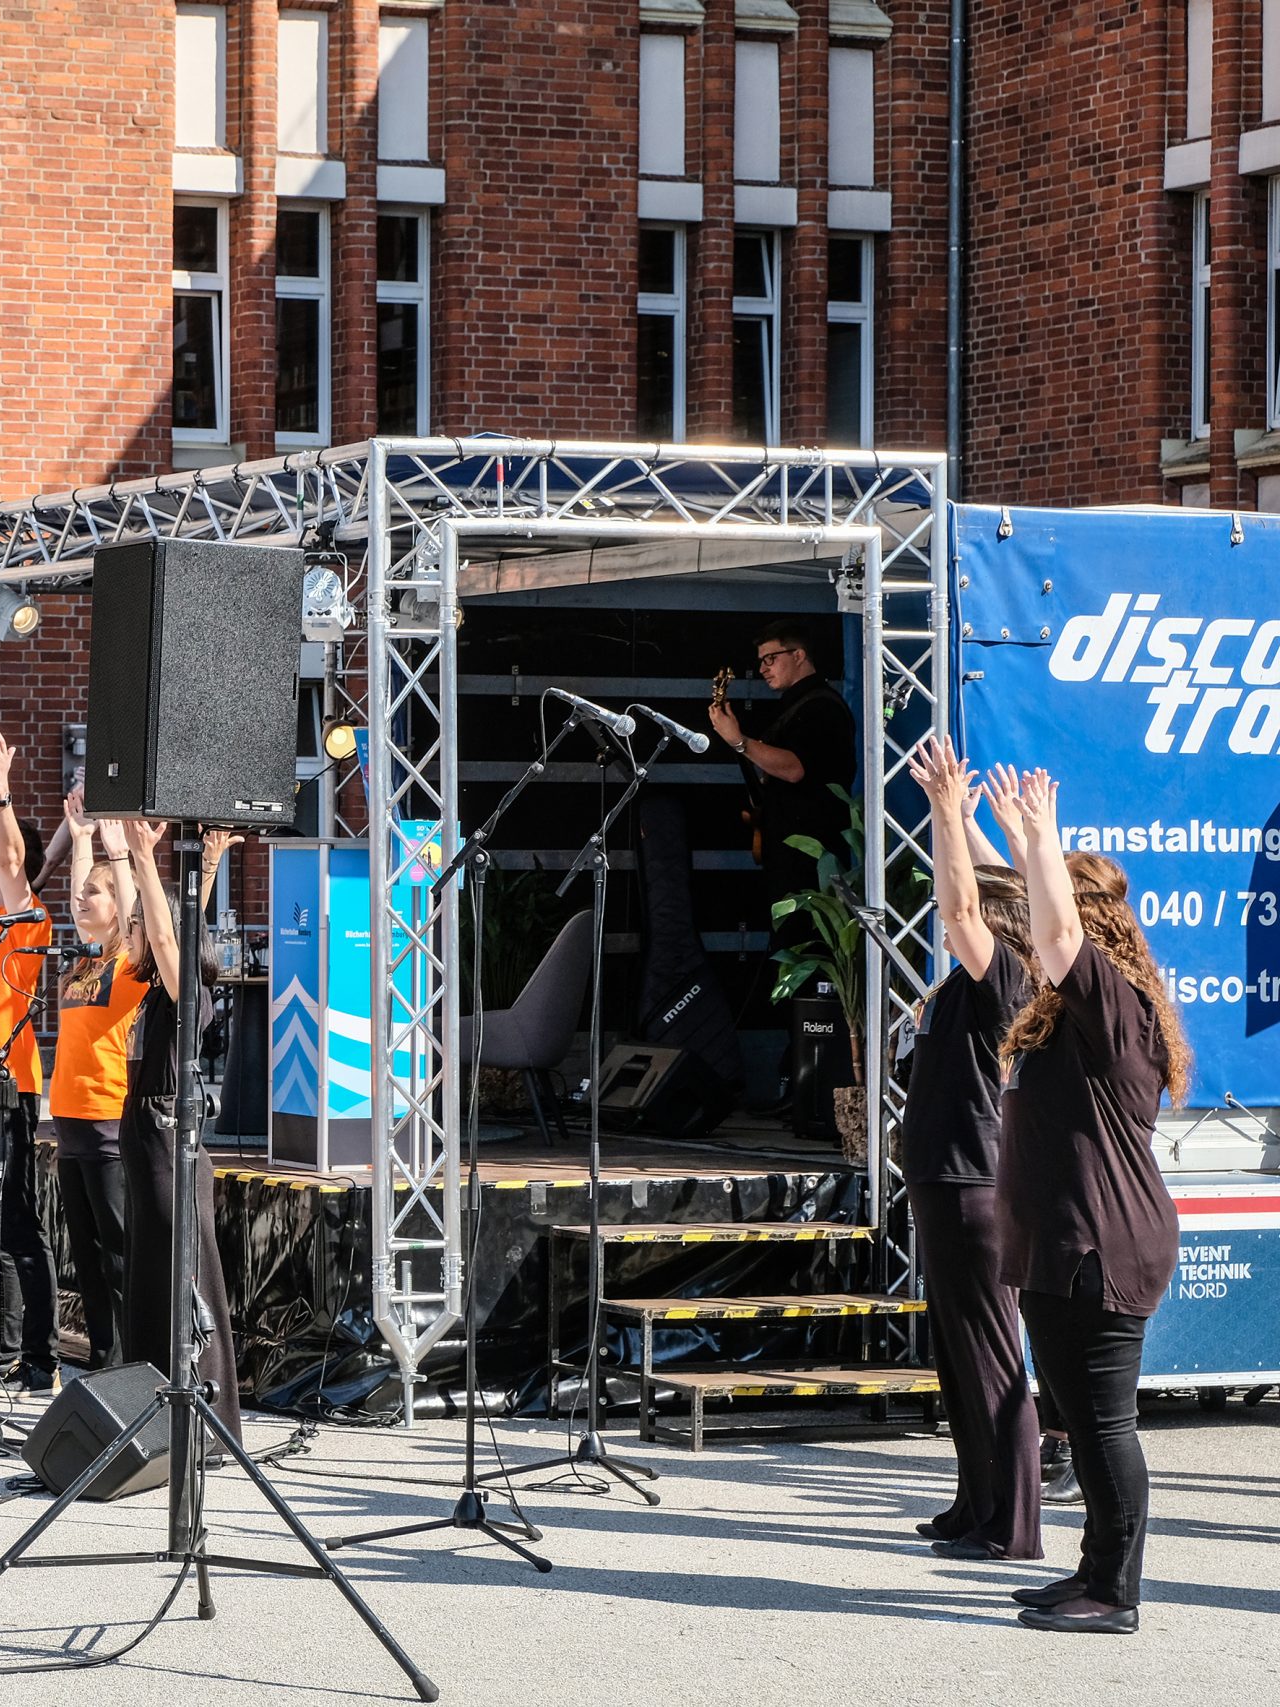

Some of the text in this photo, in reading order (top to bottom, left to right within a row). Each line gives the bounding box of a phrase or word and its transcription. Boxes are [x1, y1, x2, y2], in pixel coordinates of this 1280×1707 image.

[1049, 593, 1280, 686] disco
[1144, 670, 1280, 755] tra
[1140, 891, 1278, 927] 040 / 73
[662, 984, 702, 1023] mono
[803, 1022, 834, 1034] Roland
[1178, 1245, 1231, 1262] EVENT
[1179, 1263, 1252, 1281] TECHNIK
[1179, 1282, 1228, 1300] NORD
